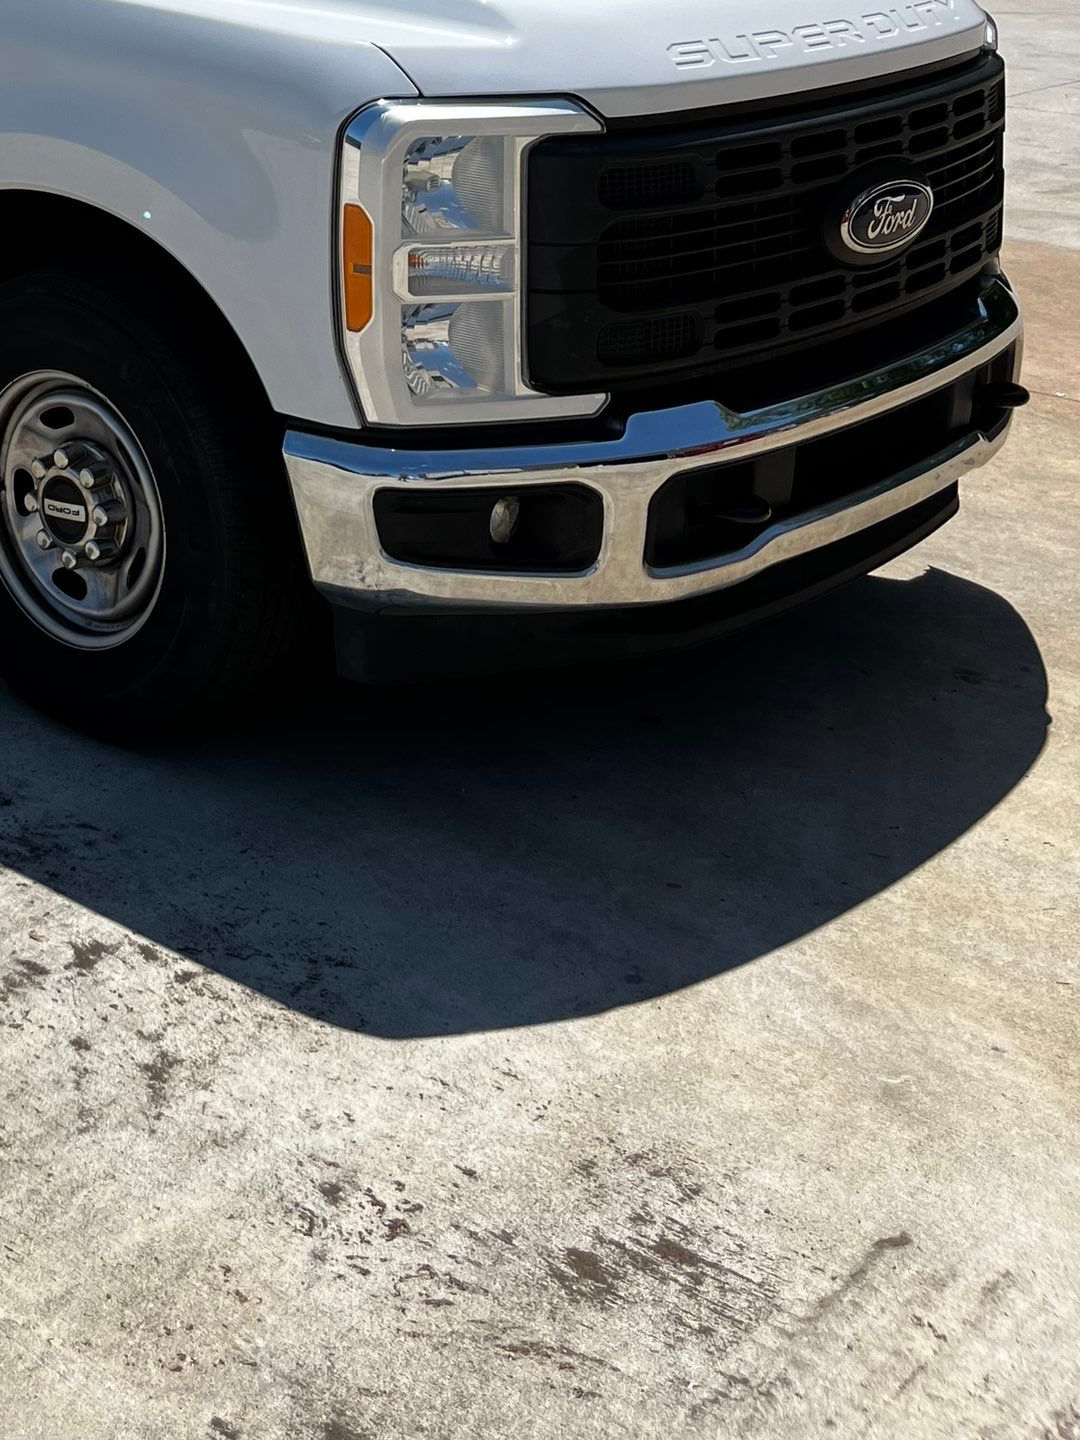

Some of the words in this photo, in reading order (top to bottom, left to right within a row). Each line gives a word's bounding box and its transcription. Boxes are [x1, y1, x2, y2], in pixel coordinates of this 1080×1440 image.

[667, 19, 865, 70] SUPER
[867, 194, 918, 241] Ford
[47, 504, 80, 515] FORD
